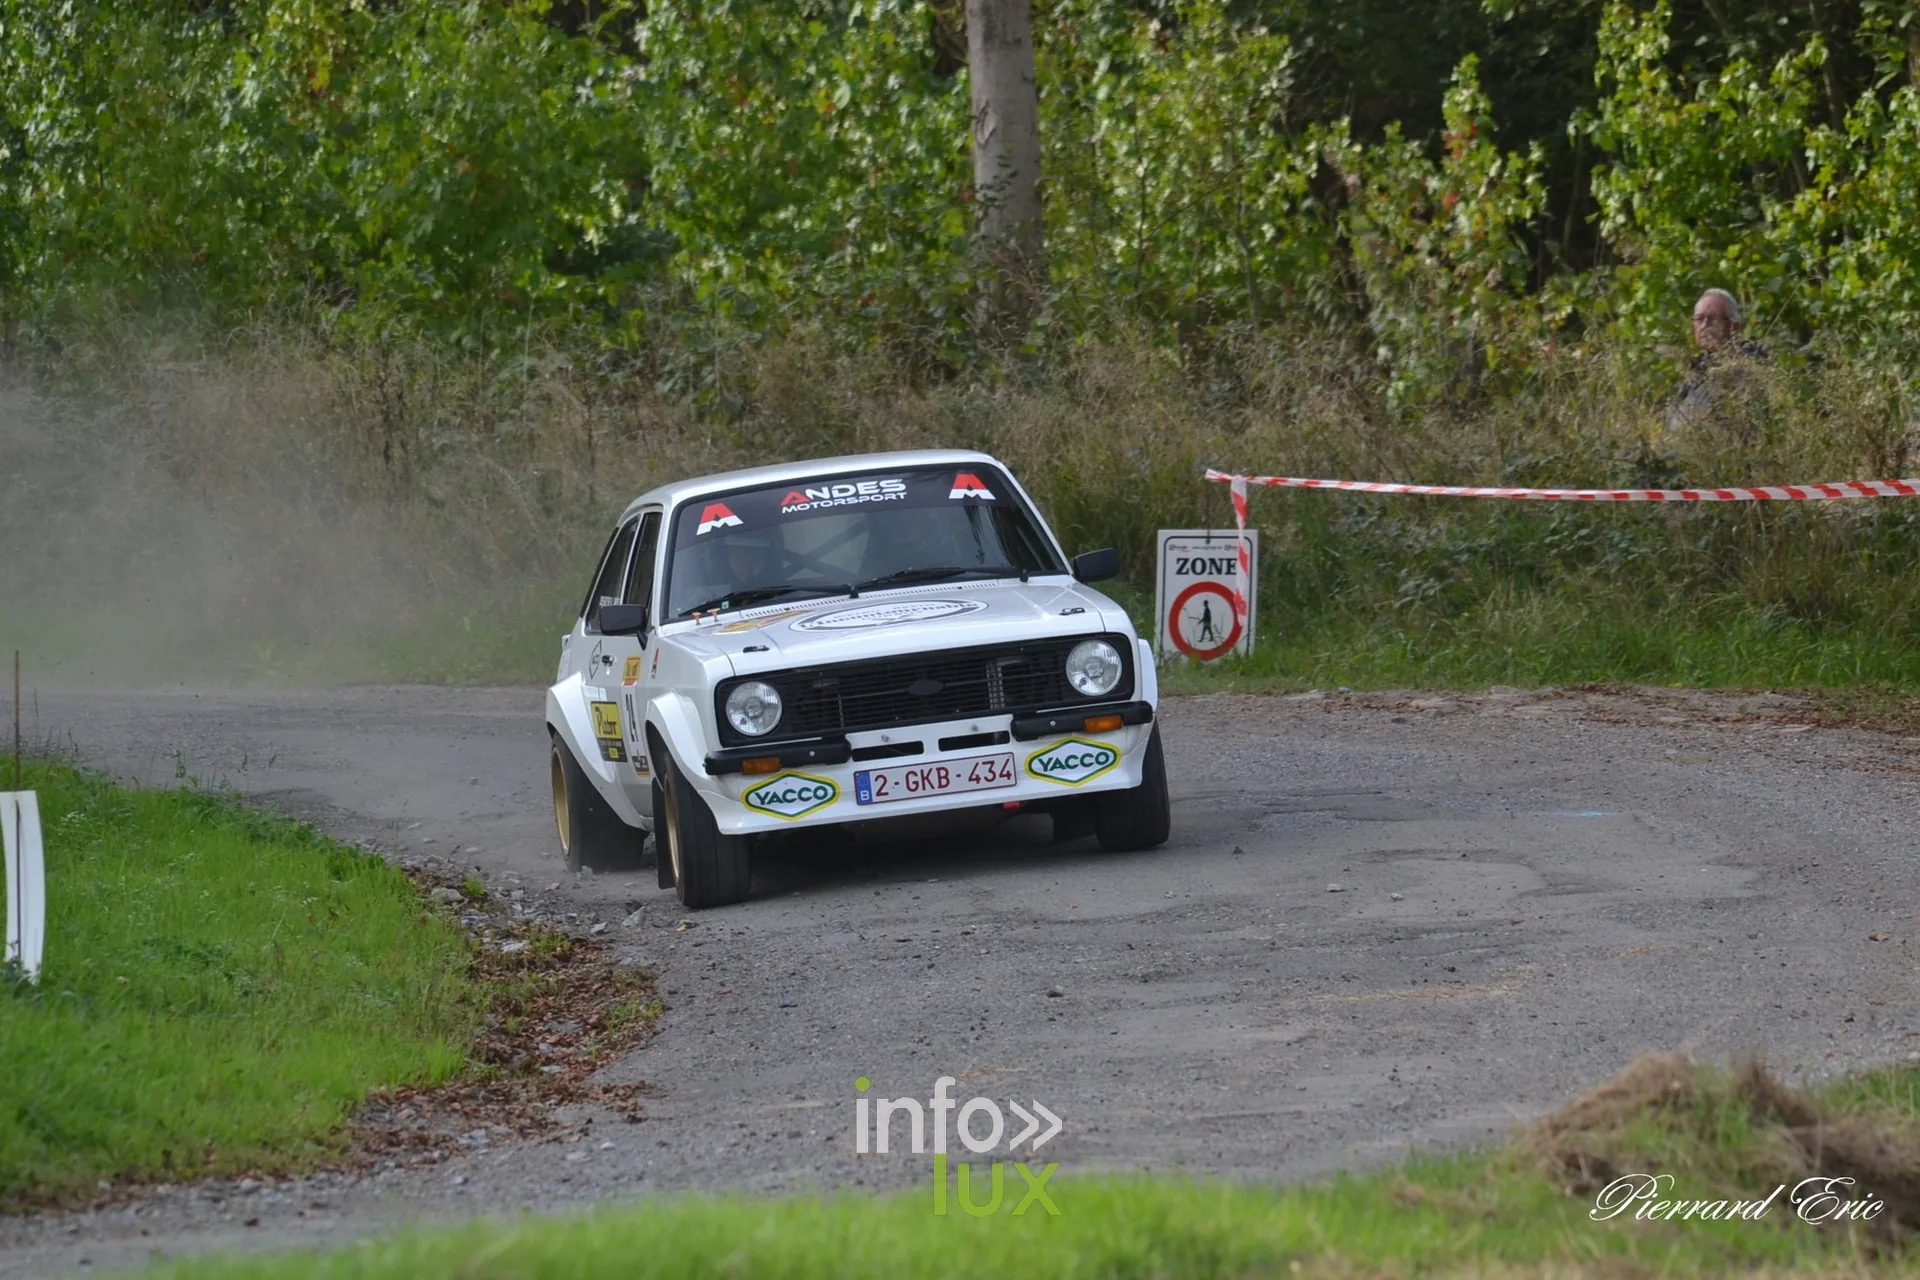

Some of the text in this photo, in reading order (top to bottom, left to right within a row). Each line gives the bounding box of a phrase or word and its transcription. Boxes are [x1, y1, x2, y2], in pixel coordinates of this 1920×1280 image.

[780, 478, 906, 506] ANDES
[781, 492, 908, 513] MOTORSPORT
[1175, 557, 1238, 576] ZONE
[1038, 751, 1110, 773] YACCO
[754, 785, 829, 805] YACCO
[860, 790, 870, 801] B
